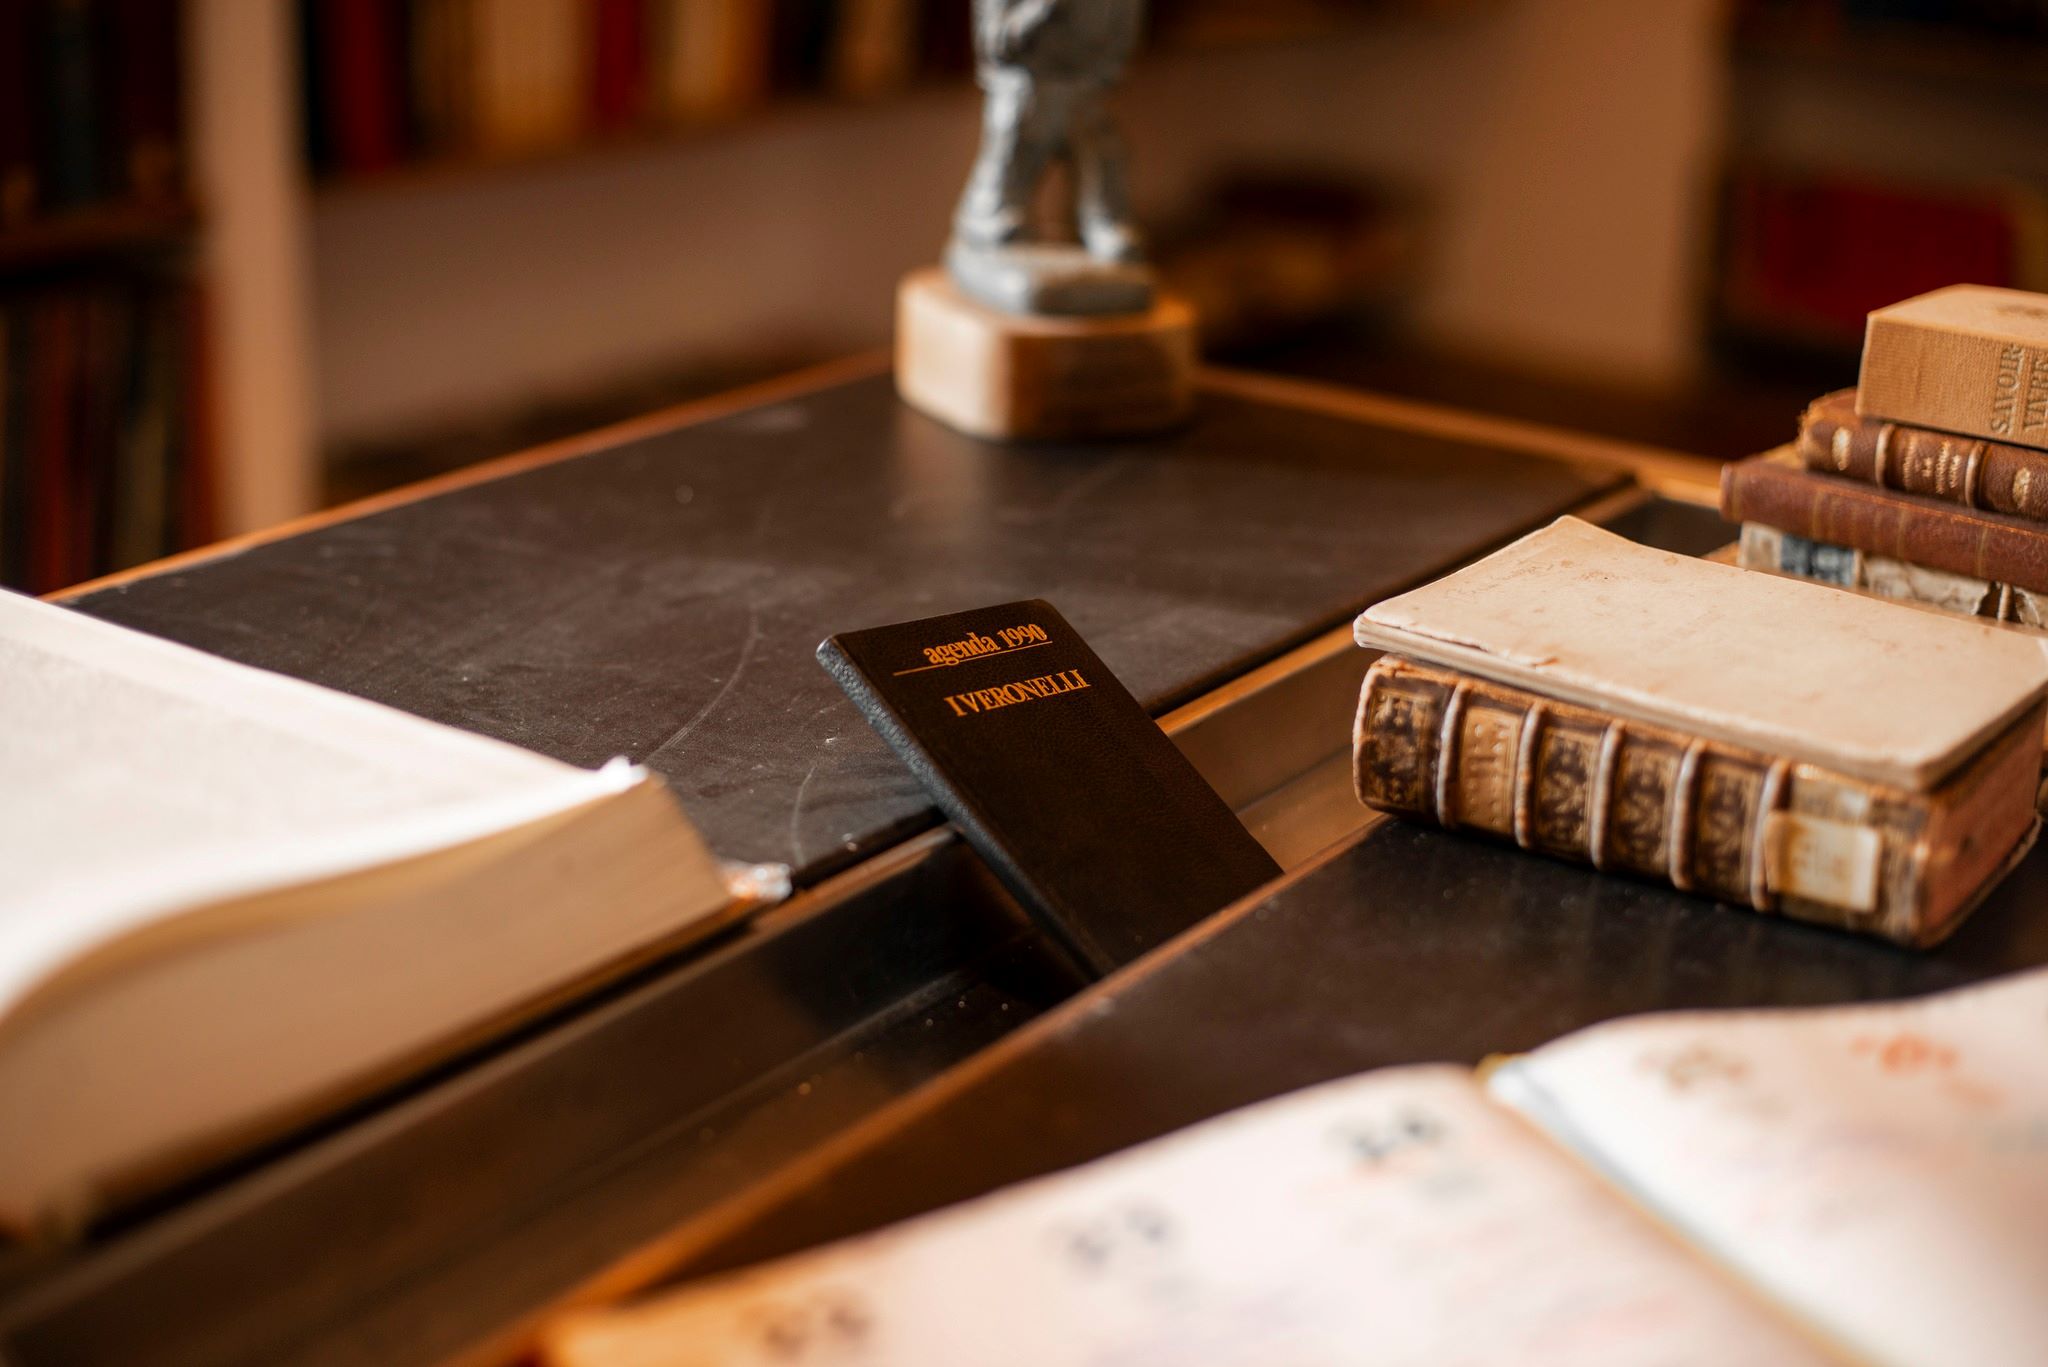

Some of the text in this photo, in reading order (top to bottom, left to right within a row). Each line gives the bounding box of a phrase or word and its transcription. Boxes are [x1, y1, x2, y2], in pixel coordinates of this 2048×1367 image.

[1991, 343, 2021, 434] SAVOIR
[923, 624, 1048, 666] agenda 1990
